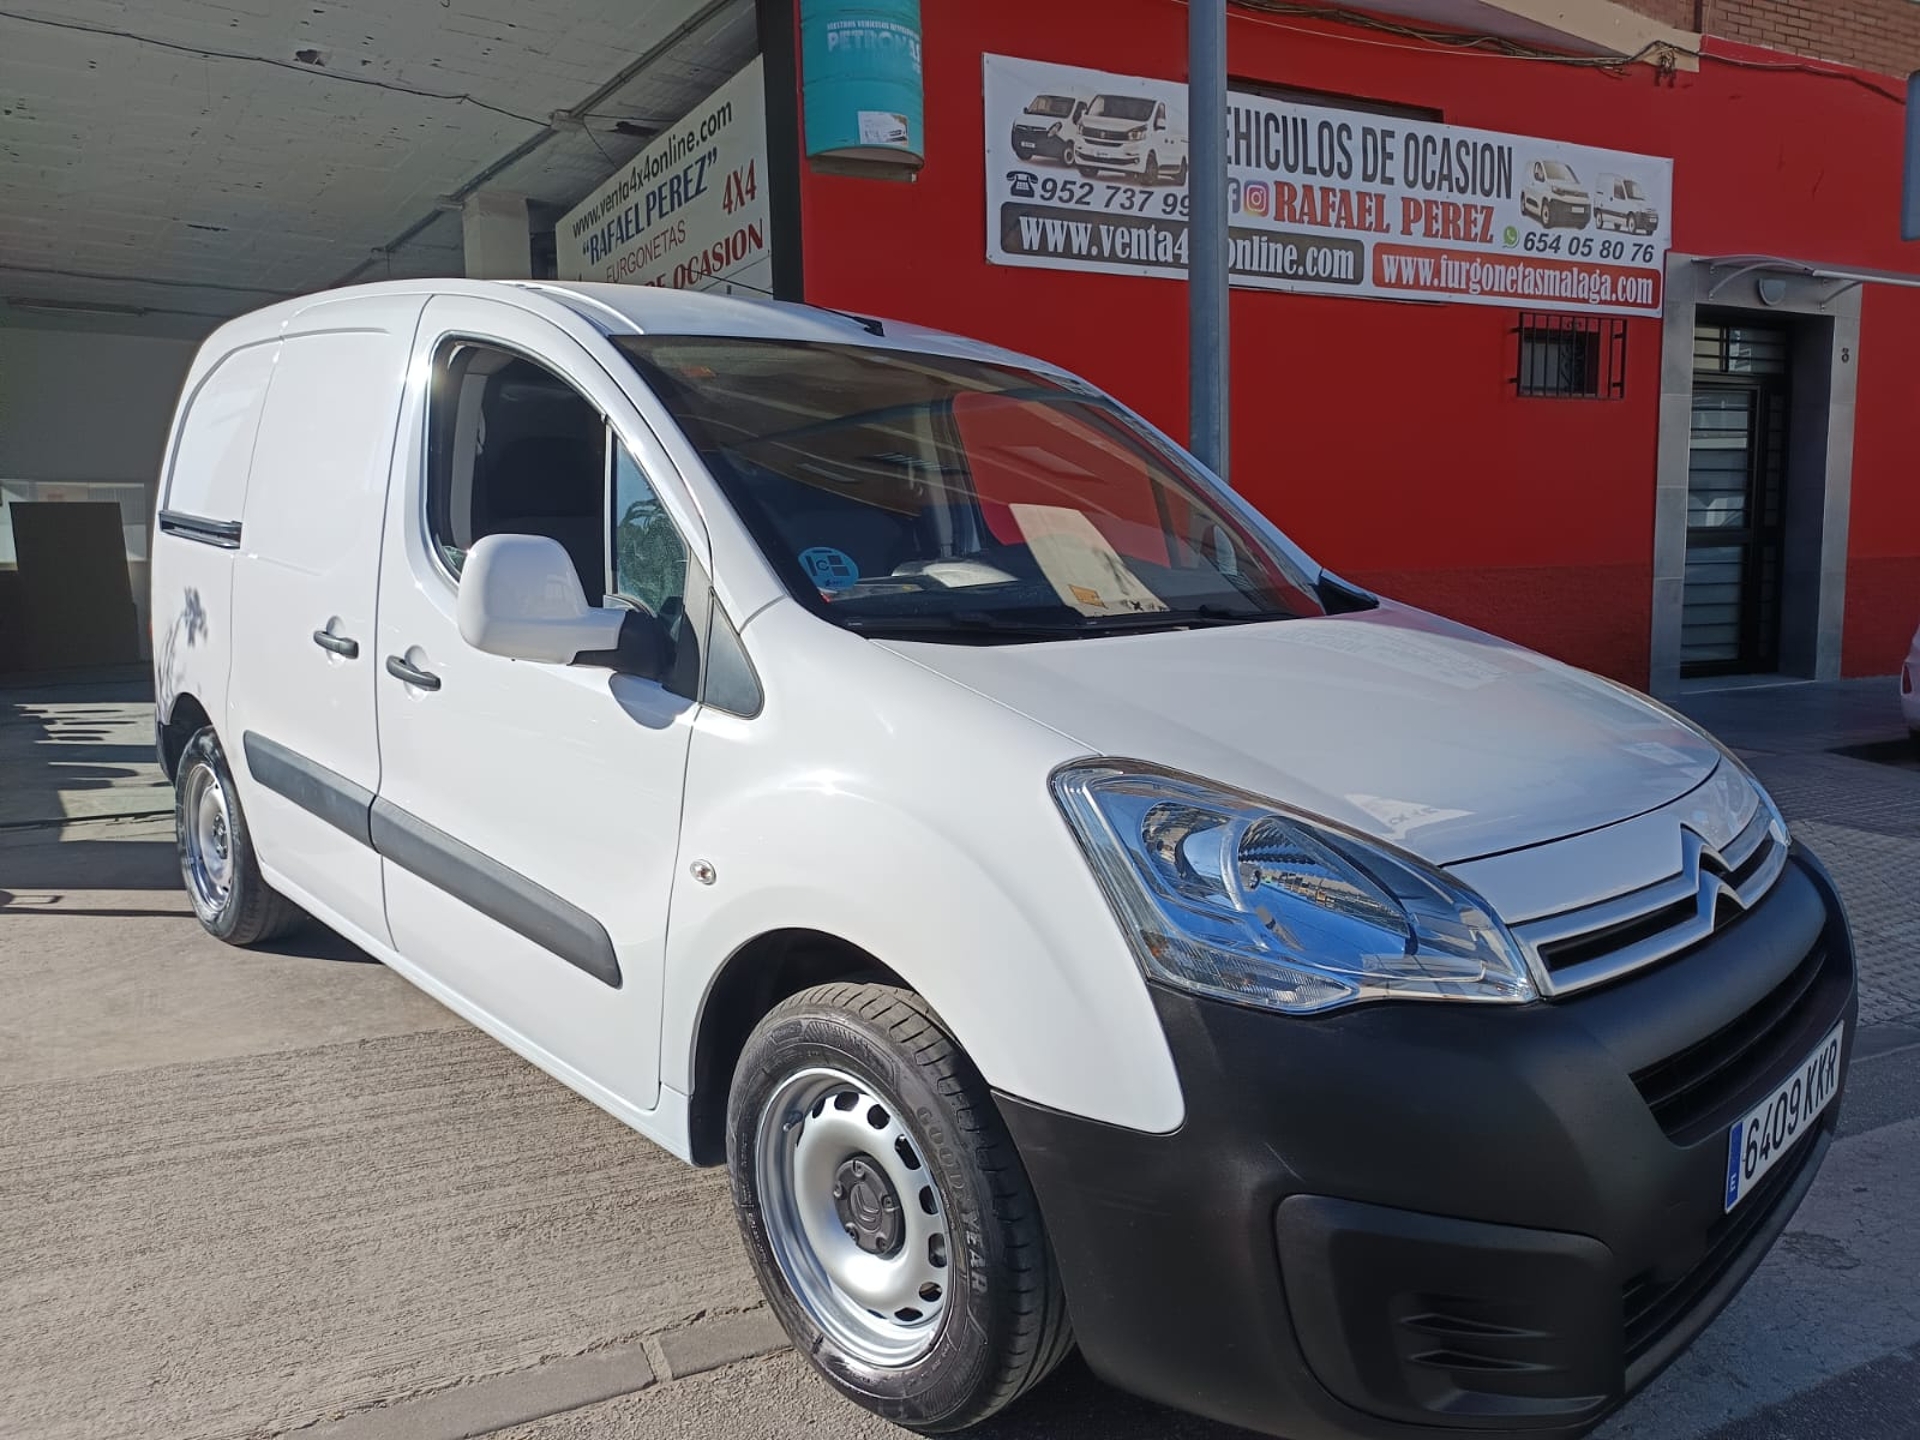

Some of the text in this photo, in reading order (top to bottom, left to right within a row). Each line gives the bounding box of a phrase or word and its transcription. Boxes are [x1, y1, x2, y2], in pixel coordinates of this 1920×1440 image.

[572, 101, 732, 239] www.venta4x4online.com
[1040, 177, 1189, 217] 952 737 99
[1361, 126, 1396, 186] DE
[1404, 132, 1513, 200] OCASION
[1274, 180, 1495, 244] RAFAEL PEREZ
[673, 218, 764, 290] OCASION
[1382, 254, 1653, 305] www.furgonetasmalaga.com
[1523, 231, 1655, 263] 654 05 80 76
[1744, 1038, 1838, 1180] 6409 KKR
